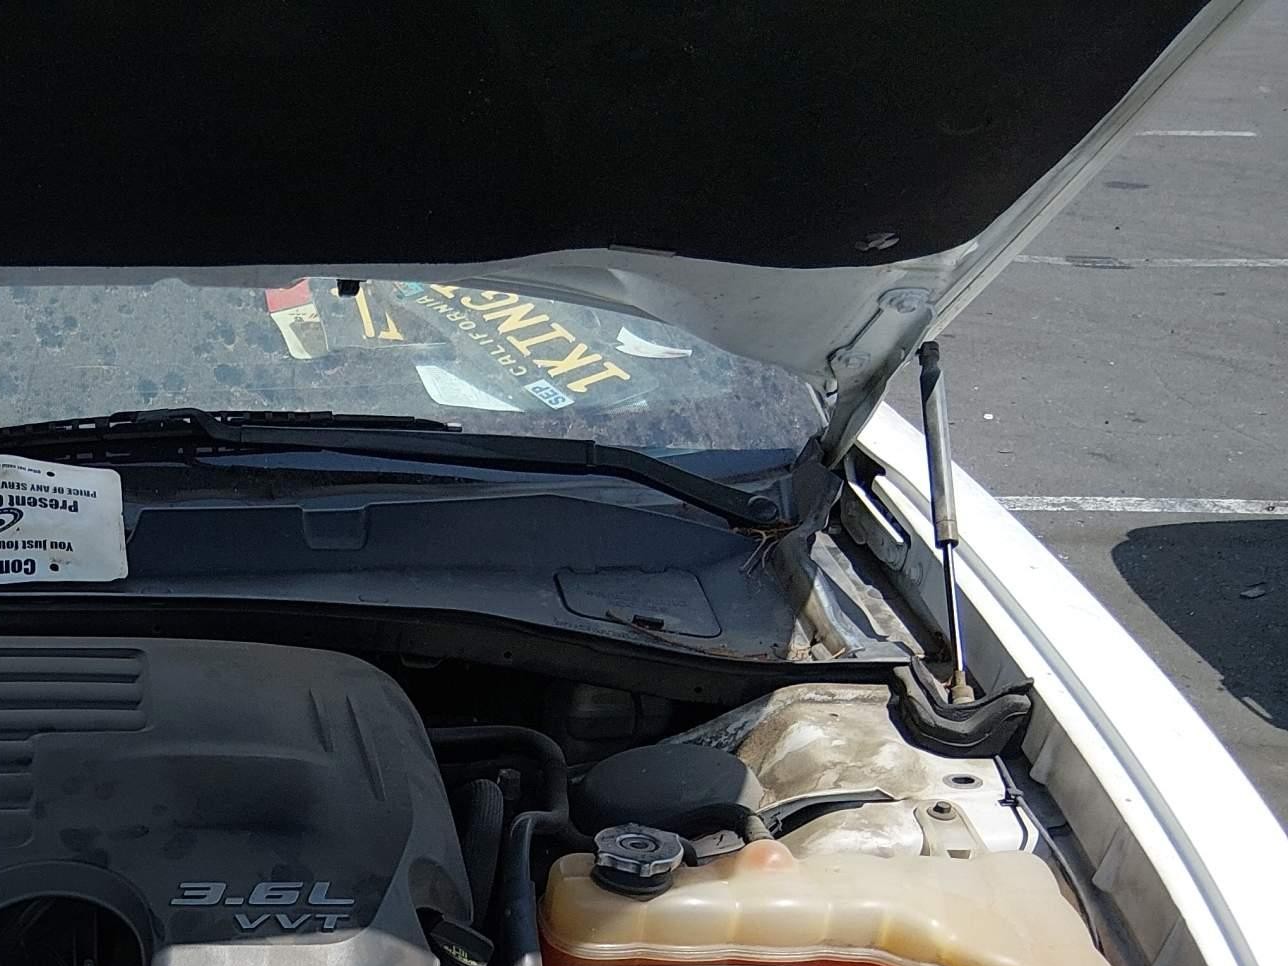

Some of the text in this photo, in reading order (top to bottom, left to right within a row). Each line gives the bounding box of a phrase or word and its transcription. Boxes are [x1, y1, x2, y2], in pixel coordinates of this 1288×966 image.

[415, 294, 528, 377] CALIFORNIA
[530, 384, 567, 408] SEP
[30, 483, 50, 493] ANY
[51, 486, 65, 495] OF
[67, 487, 97, 498] PRICE
[8, 495, 79, 513] Present
[22, 540, 47, 551] just
[50, 541, 73, 552] You
[170, 881, 355, 906] 3.6L
[234, 913, 350, 930] VVT
